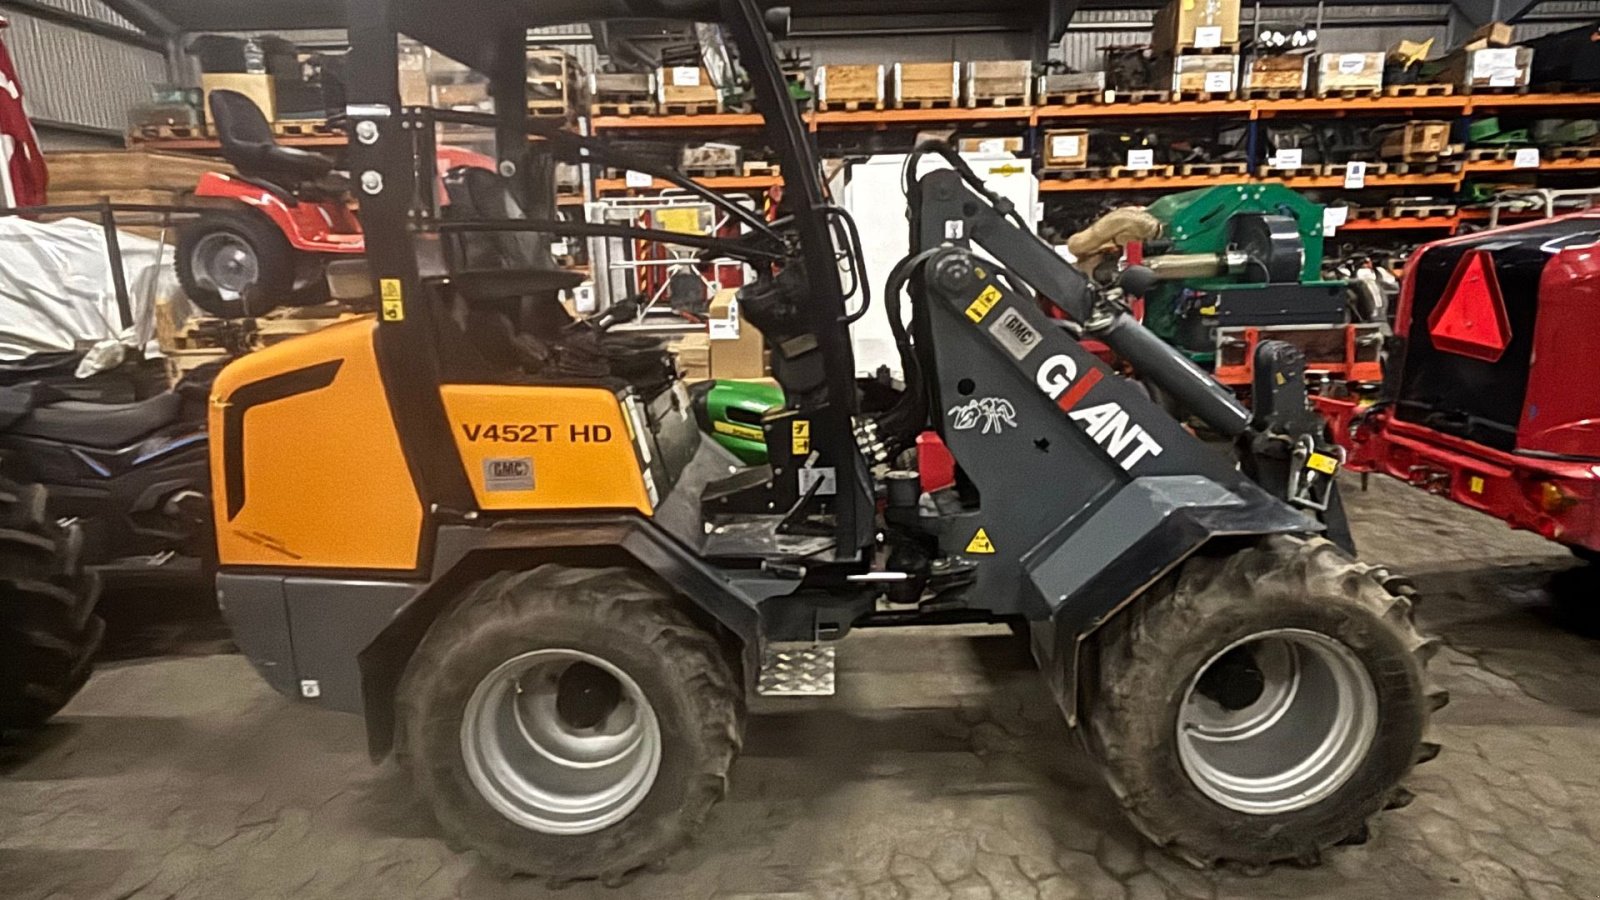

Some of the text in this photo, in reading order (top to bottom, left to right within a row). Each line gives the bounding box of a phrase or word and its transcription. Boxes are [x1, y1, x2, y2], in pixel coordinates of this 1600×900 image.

[1005, 316, 1033, 343] GMC
[1036, 354, 1163, 471] GIANT
[462, 424, 612, 443] V452T HD
